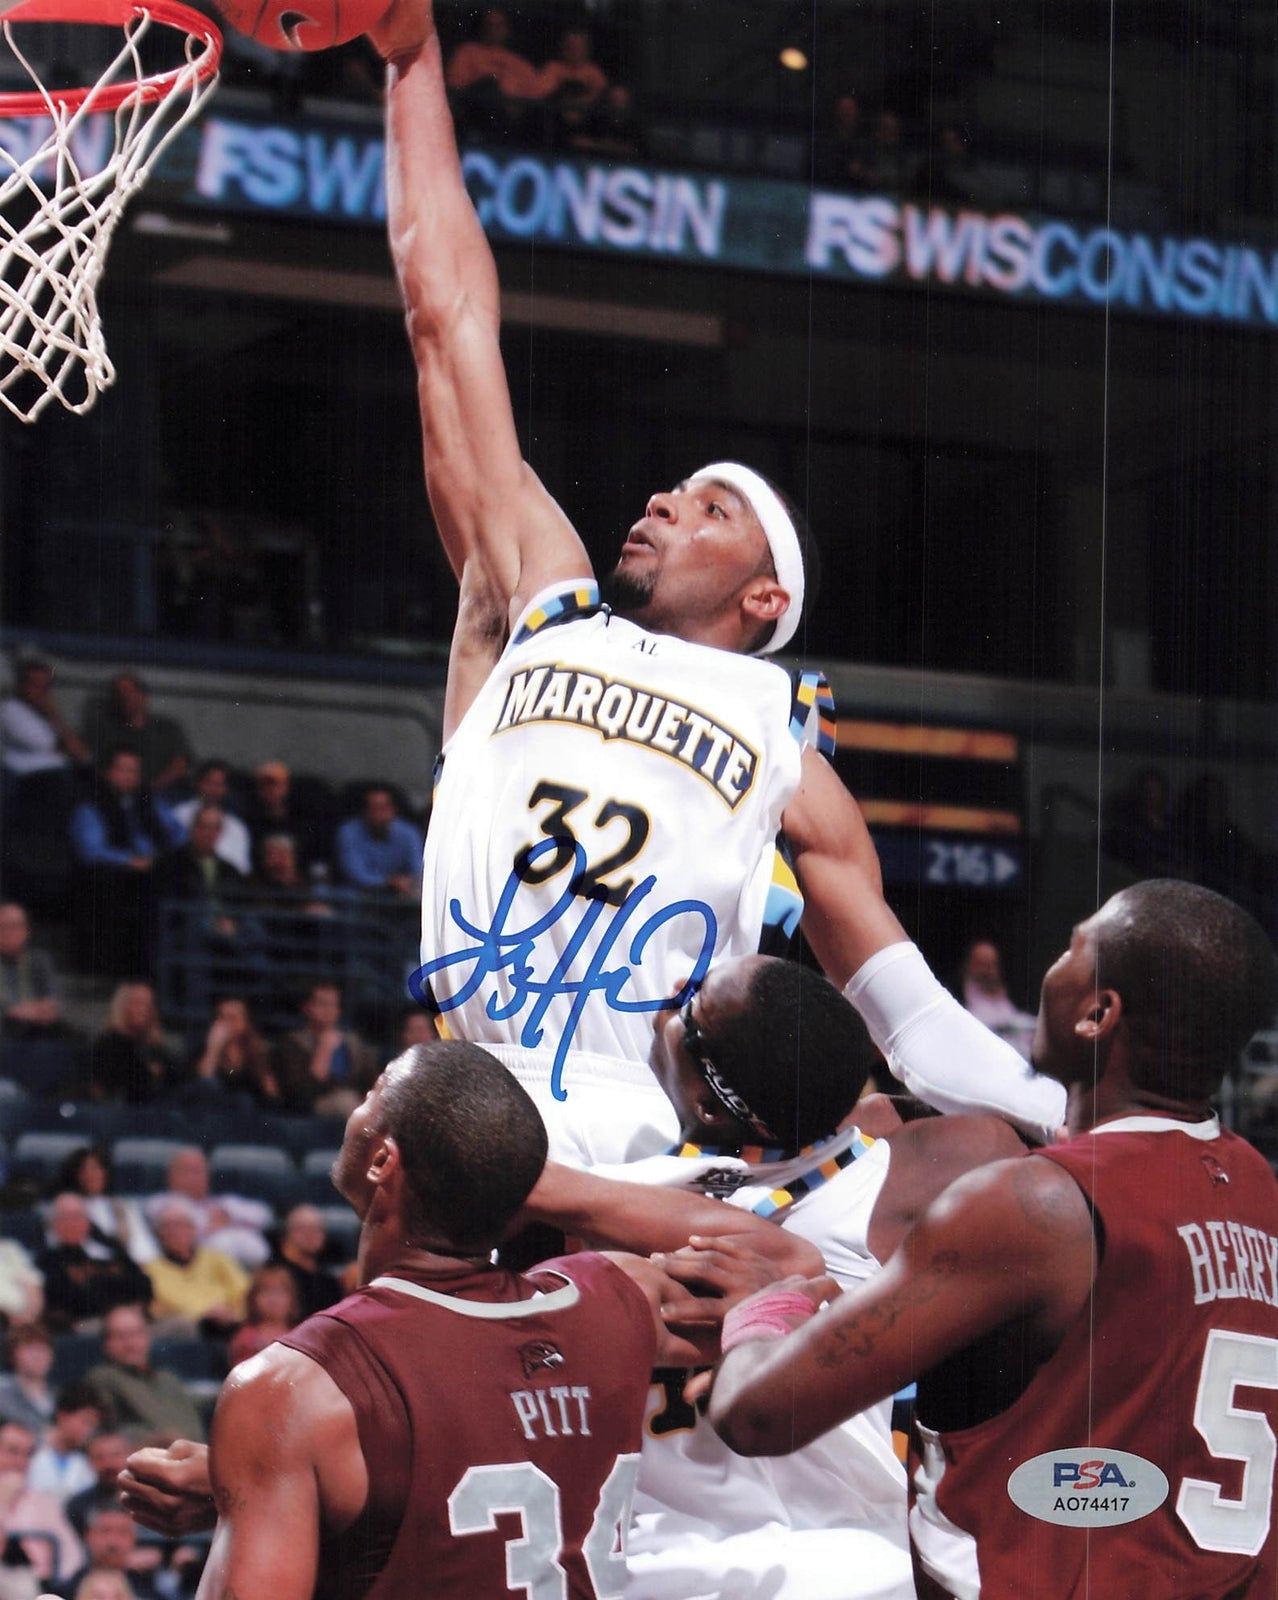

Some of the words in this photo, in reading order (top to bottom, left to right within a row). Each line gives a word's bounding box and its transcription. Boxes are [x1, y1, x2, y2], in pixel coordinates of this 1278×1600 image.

[494, 664, 757, 803] MARQUETTE
[513, 779, 650, 908] 32
[927, 841, 988, 885] 216
[510, 1385, 592, 1440] PITT
